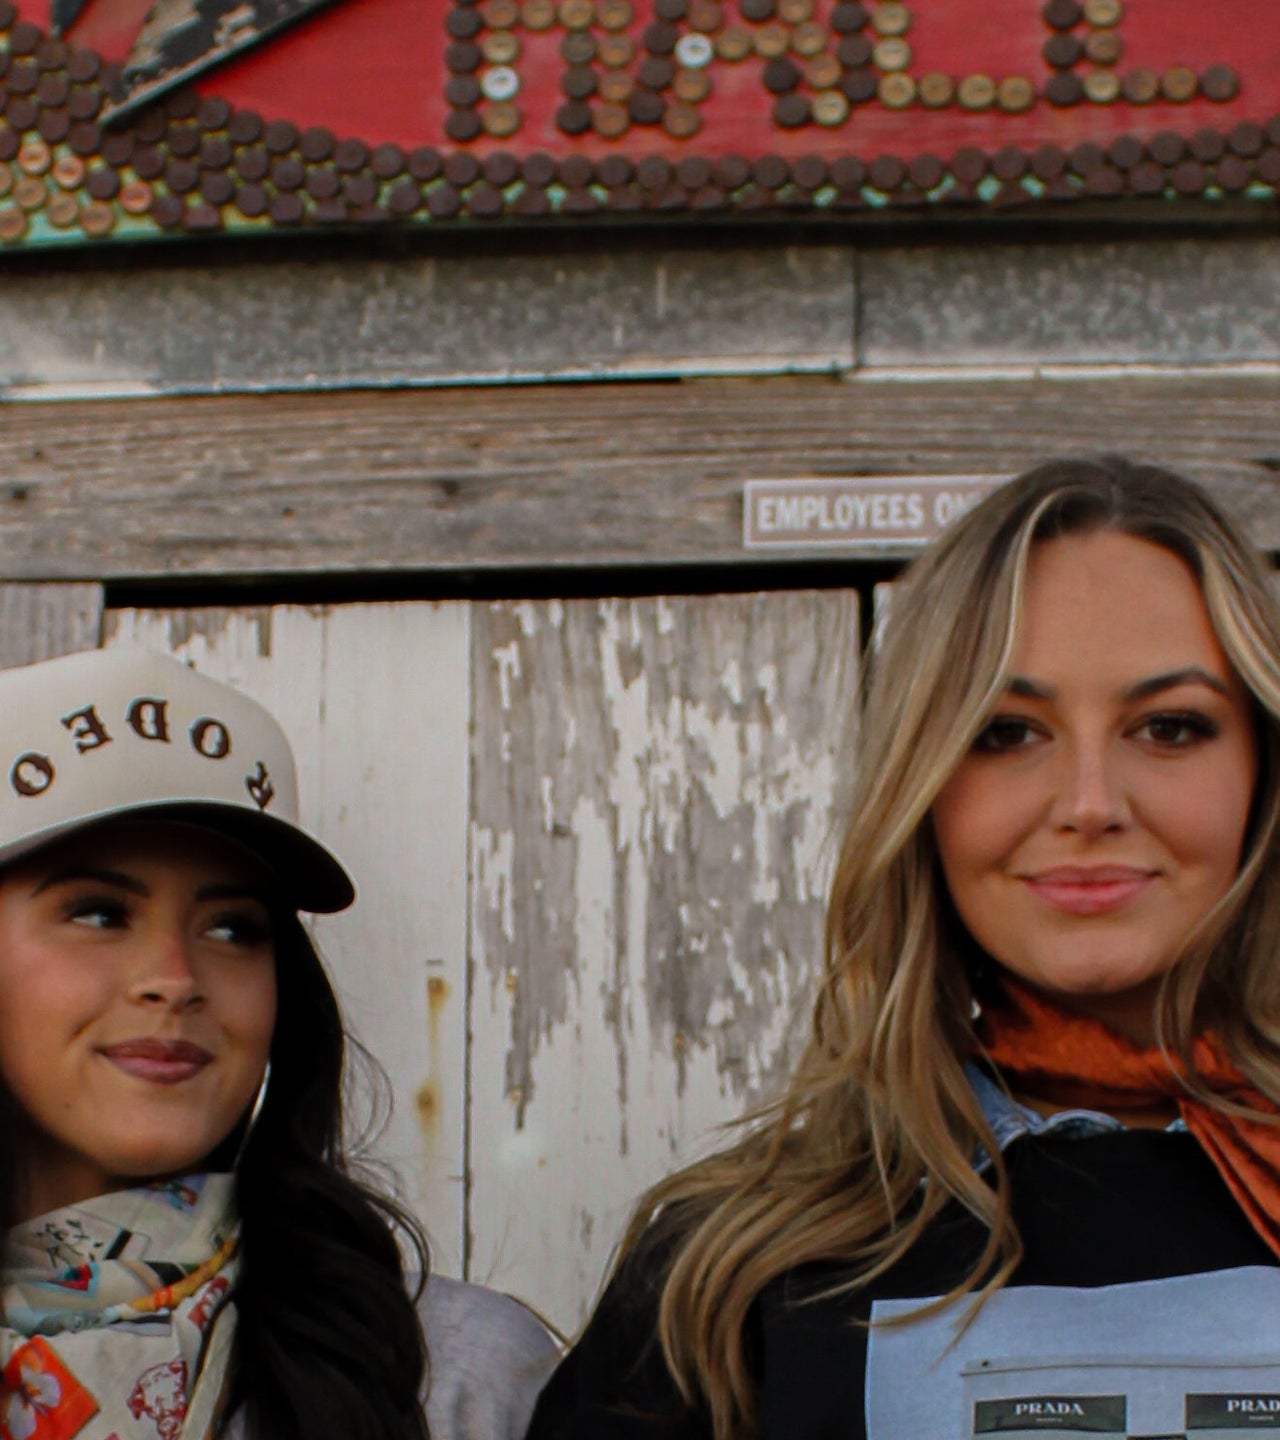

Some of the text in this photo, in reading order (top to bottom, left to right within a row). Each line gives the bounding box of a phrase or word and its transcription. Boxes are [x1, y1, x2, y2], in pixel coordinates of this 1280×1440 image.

[757, 492, 924, 532] EMPLOYEES
[10, 696, 276, 809] RODEO
[1015, 1402, 1085, 1417] PRADA
